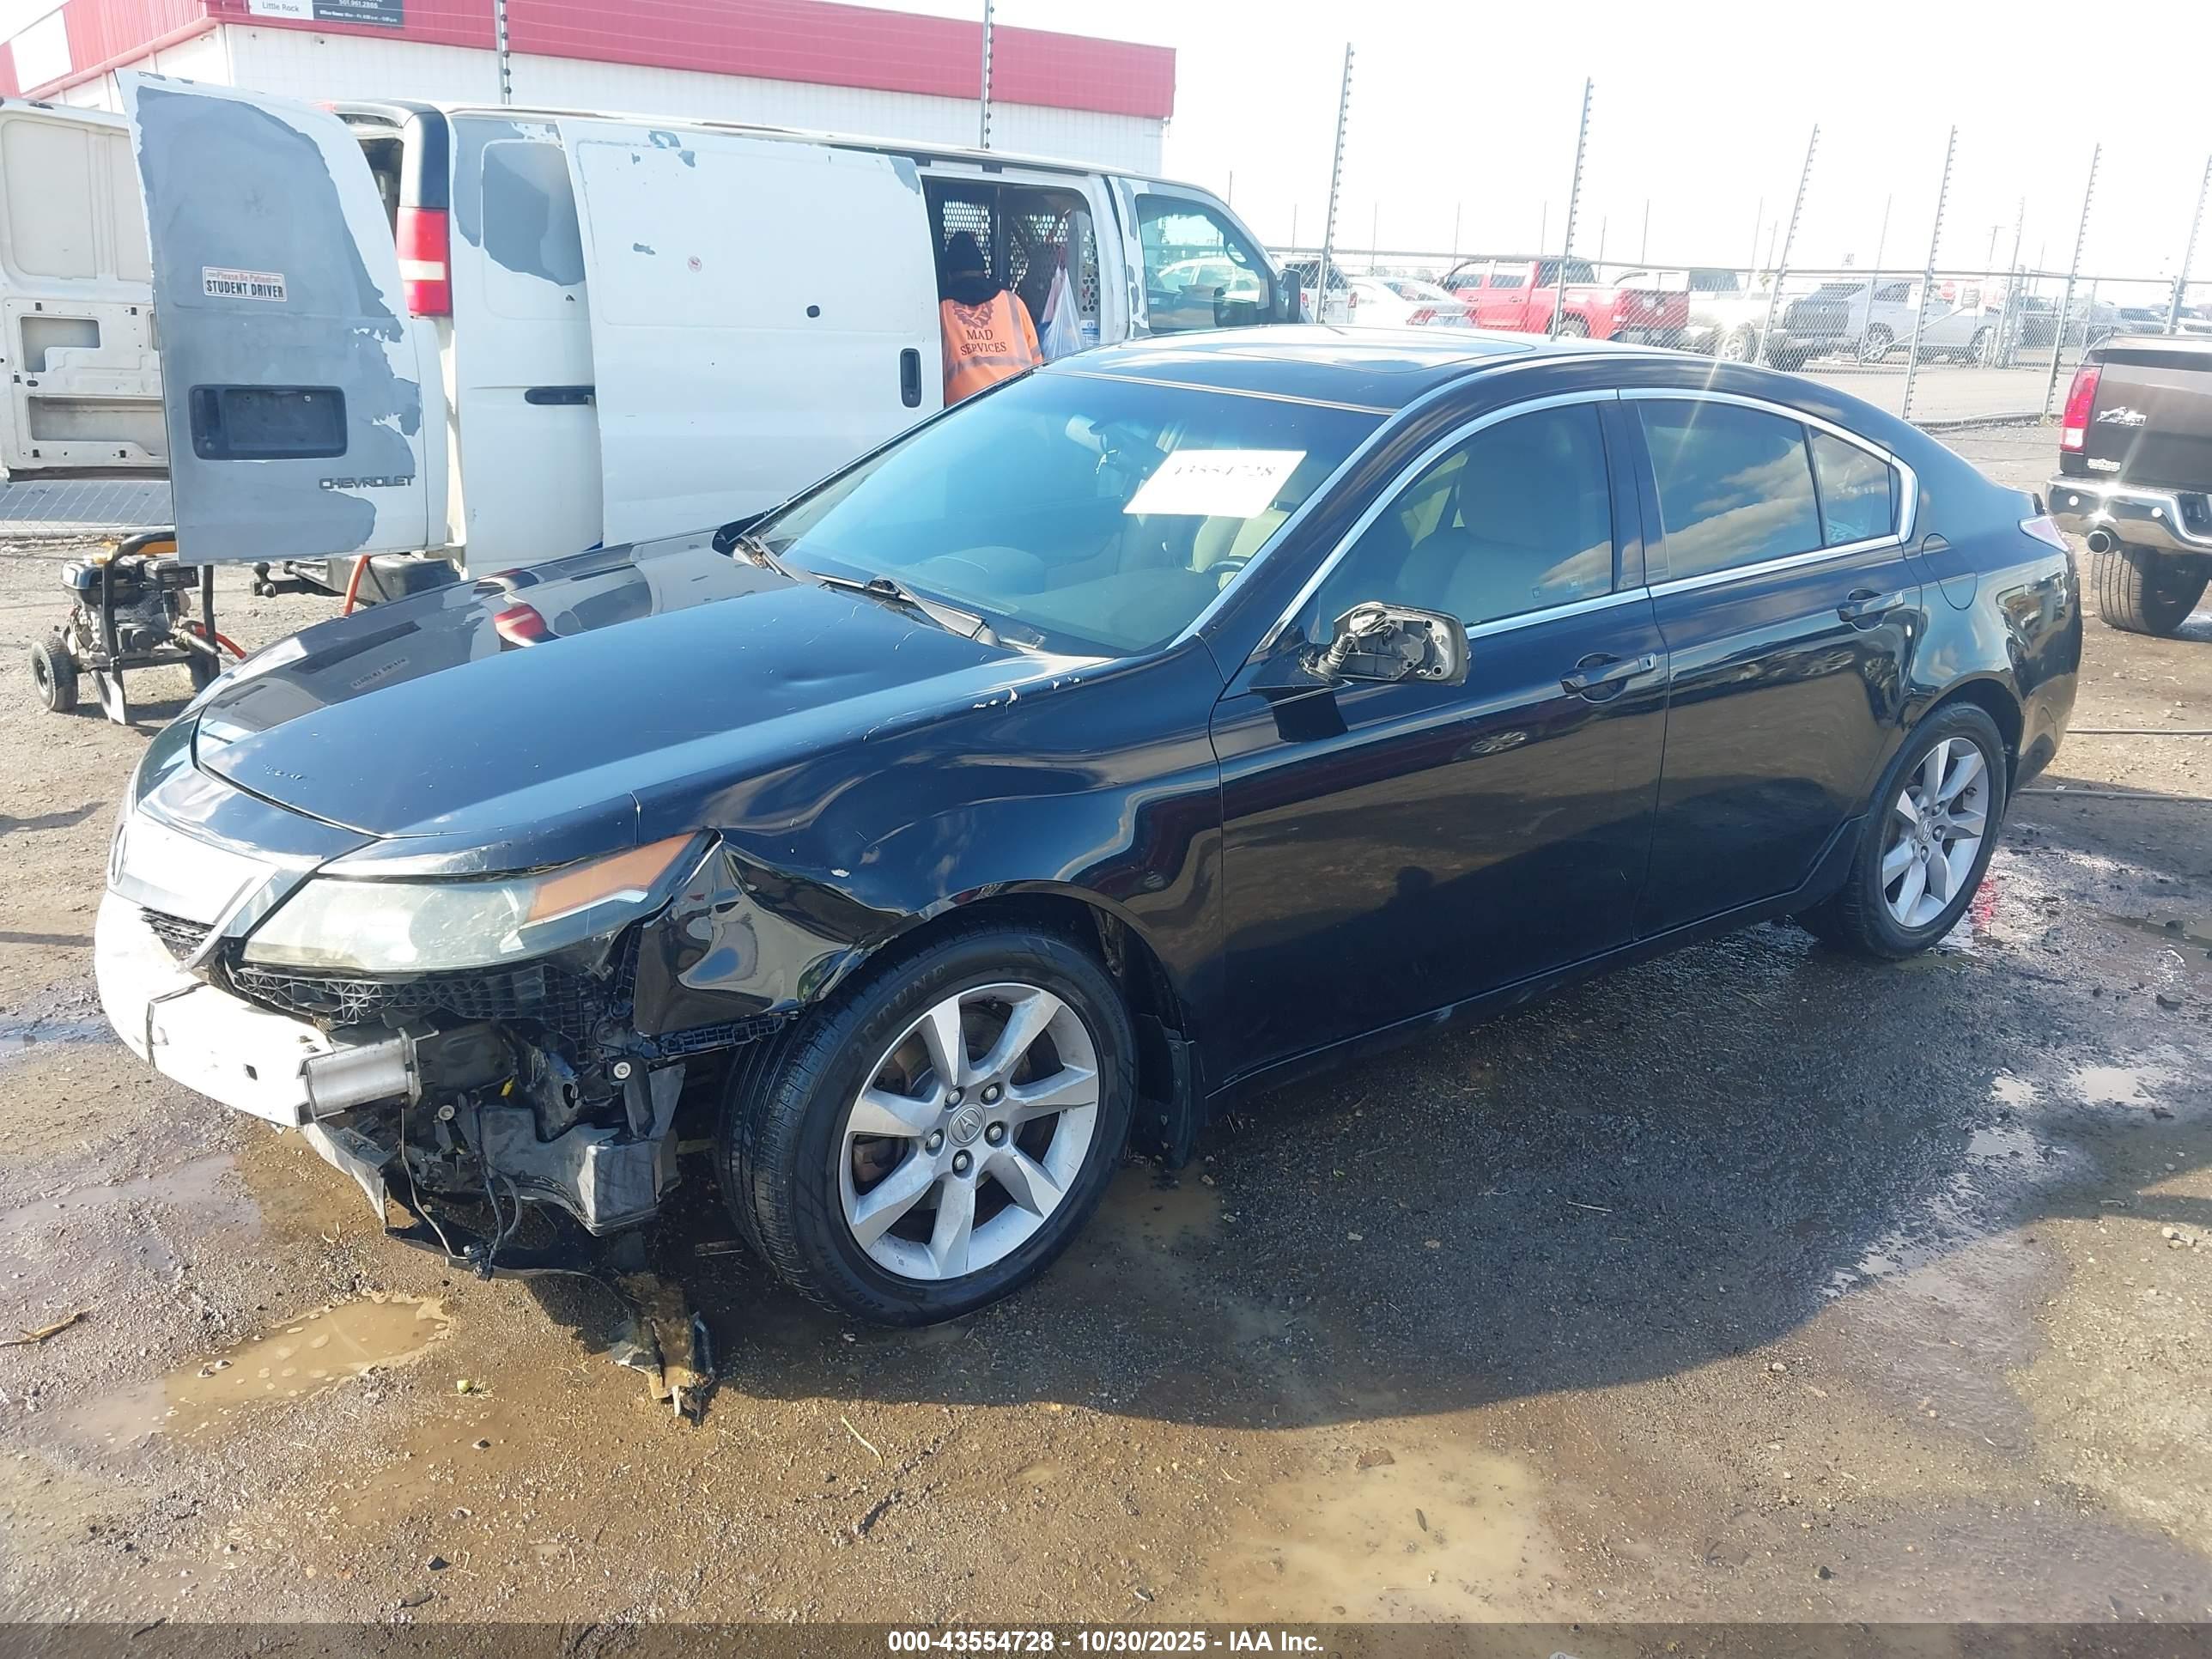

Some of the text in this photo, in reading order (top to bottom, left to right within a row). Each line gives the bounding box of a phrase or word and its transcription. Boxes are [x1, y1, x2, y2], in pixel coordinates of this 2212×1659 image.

[262, 1, 300, 12] Little Rock
[206, 280, 284, 298] STUDENT DRIVER
[966, 329, 994, 341] MAD
[960, 341, 1007, 356] SERVICES
[319, 475, 416, 489] CHEVROLET
